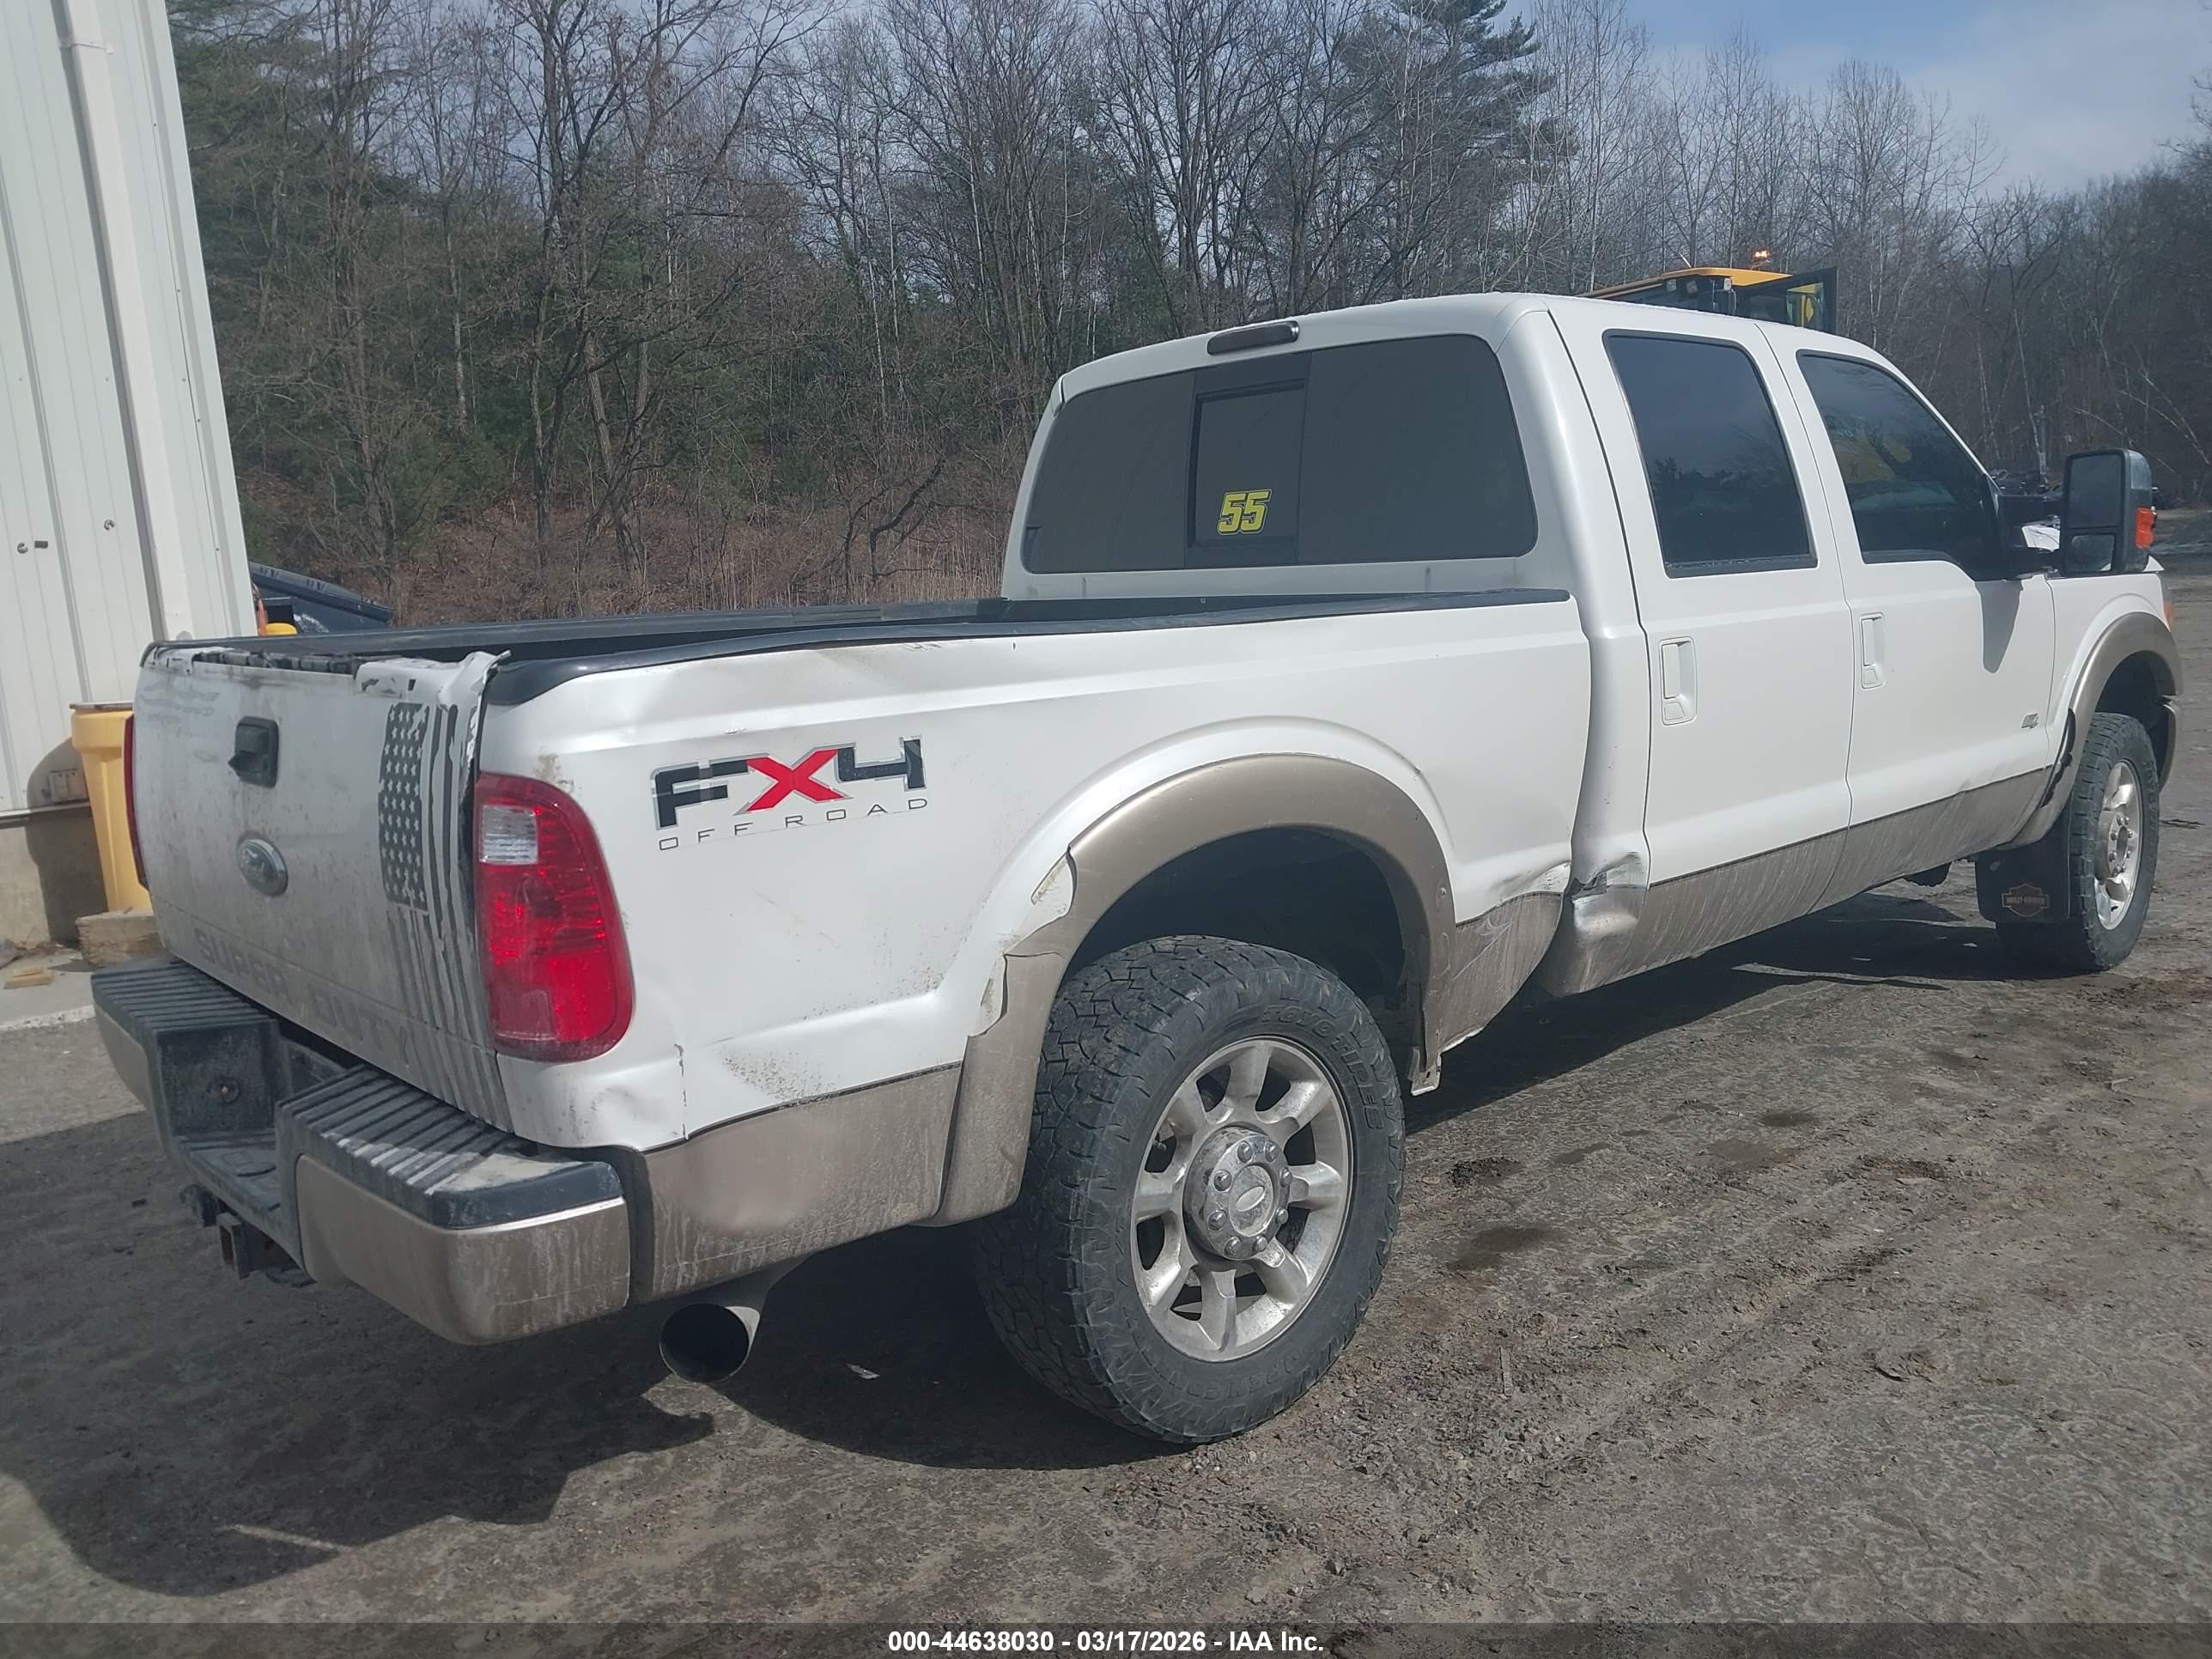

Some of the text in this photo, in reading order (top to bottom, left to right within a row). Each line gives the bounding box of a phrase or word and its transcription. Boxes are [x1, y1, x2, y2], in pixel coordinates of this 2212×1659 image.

[1216, 489, 1272, 536] 55
[651, 735, 927, 830] FX4
[658, 798, 928, 852] OFF ROAD
[1261, 1004, 1336, 1038] TOYO
